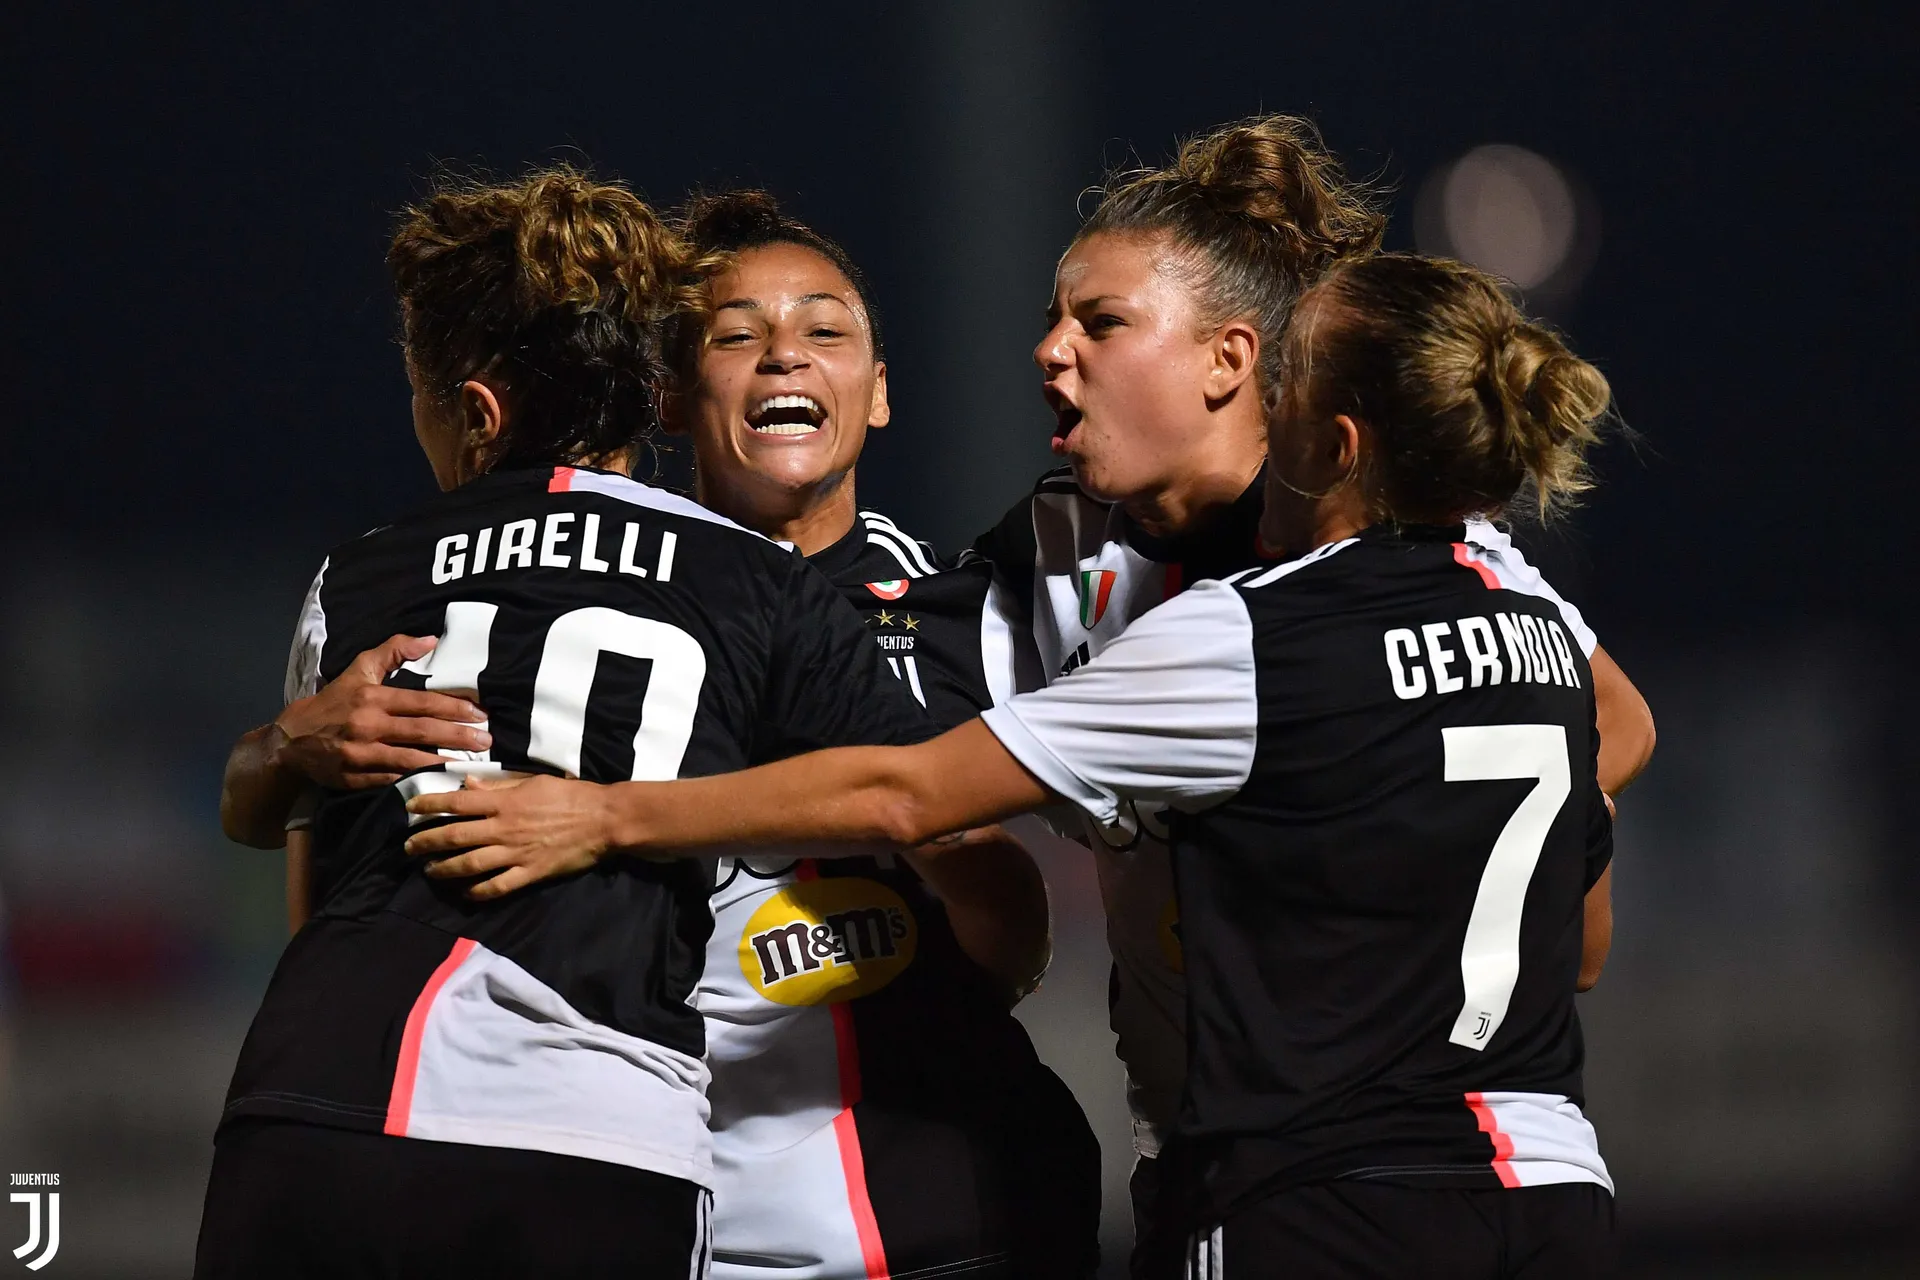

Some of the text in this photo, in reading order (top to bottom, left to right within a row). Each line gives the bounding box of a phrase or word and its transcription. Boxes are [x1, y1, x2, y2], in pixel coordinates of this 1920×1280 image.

[431, 512, 678, 585] GIRELLI
[875, 635, 915, 650] VENTUS
[1383, 611, 1582, 700] CERNOIA
[390, 601, 707, 824] 10
[1441, 723, 1572, 1052] 7
